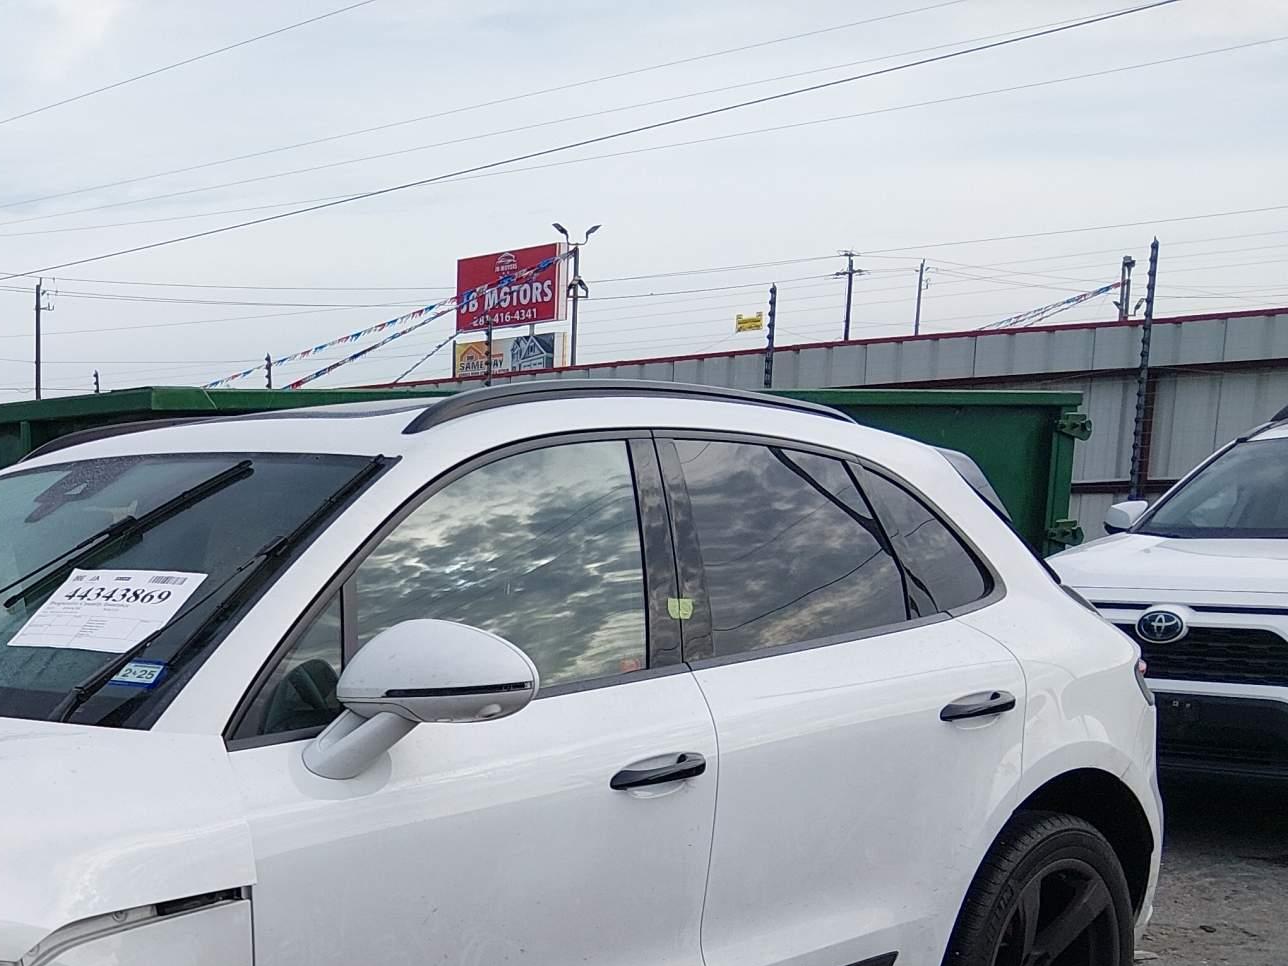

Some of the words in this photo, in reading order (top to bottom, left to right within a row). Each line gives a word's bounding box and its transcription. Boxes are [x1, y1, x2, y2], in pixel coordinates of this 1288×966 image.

[484, 280, 552, 311] MOTORS
[473, 308, 537, 326] 281416-4341
[459, 360, 484, 371] SAME
[64, 587, 172, 605] 44343869
